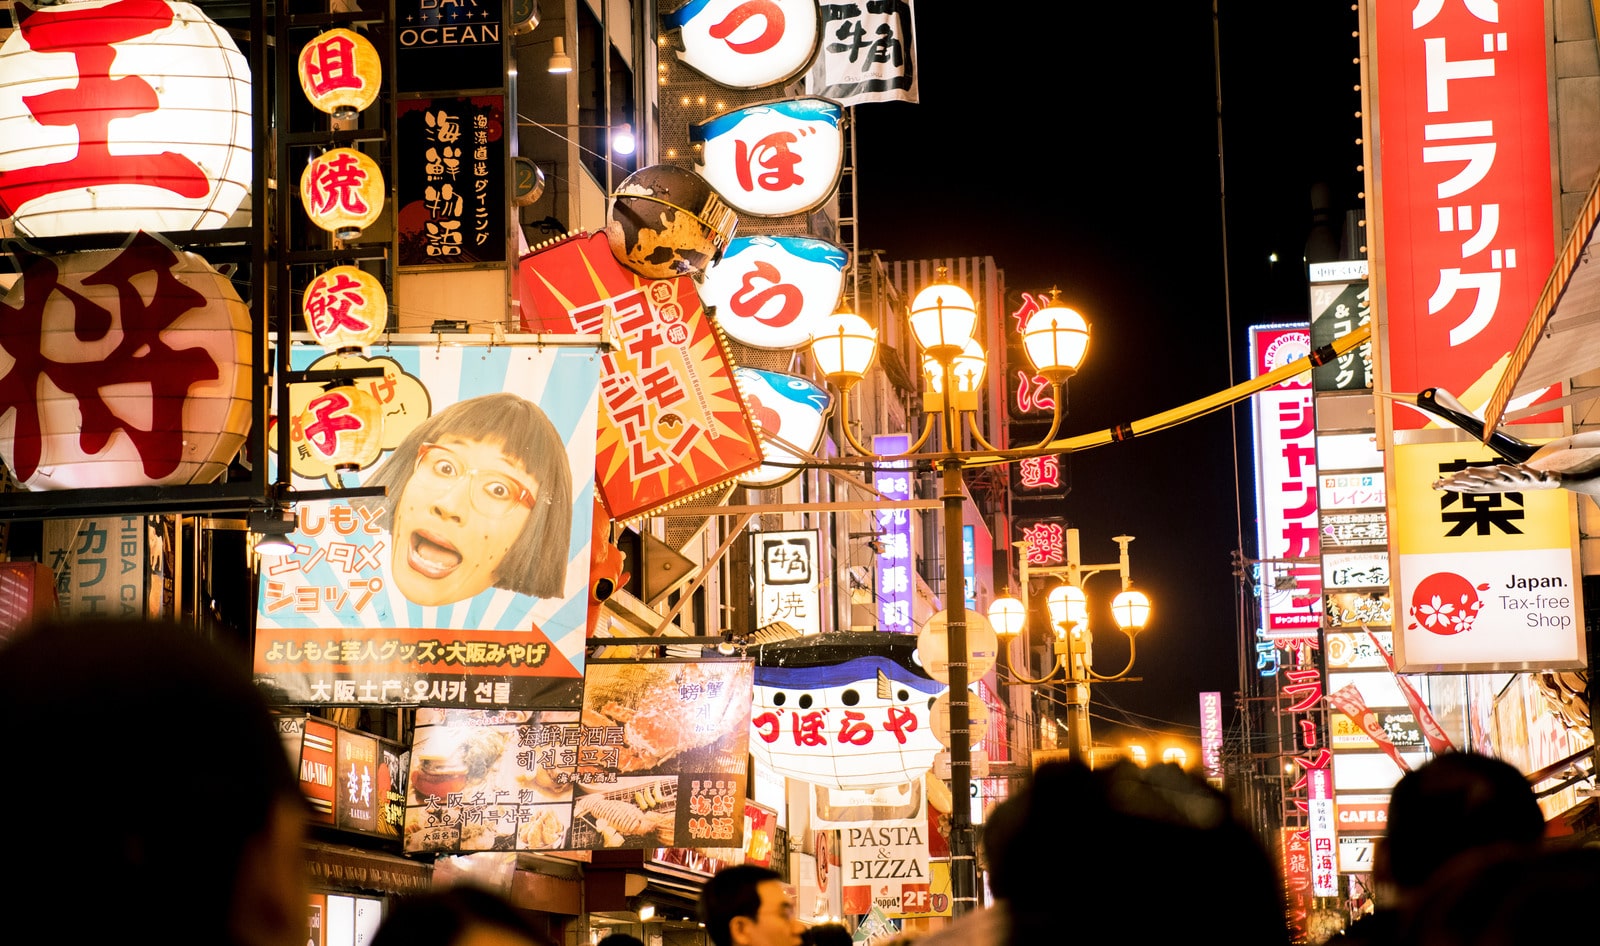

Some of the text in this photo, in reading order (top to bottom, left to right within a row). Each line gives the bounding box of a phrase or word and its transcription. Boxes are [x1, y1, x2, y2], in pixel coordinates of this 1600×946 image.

[400, 25, 499, 46] OCEAN
[826, 20, 904, 72] 牛角
[424, 110, 463, 256] 海鮮物語
[1334, 304, 1354, 389] &コック
[291, 504, 385, 536] しもと
[770, 547, 806, 575] 牛角
[1332, 566, 1390, 585] ぼて茶
[1505, 574, 1568, 591] Japan.
[263, 577, 385, 614] ショップ
[1499, 595, 1570, 610] Tax-free
[1526, 613, 1571, 630] Shop
[474, 681, 511, 704] 선물
[752, 706, 918, 747] づぼらや
[516, 748, 620, 772] 해선호프집
[1339, 810, 1376, 823] CAFE
[848, 826, 924, 847] PASTA
[877, 848, 890, 859] &
[851, 859, 924, 879] PIZZA
[903, 890, 927, 906] 2F
